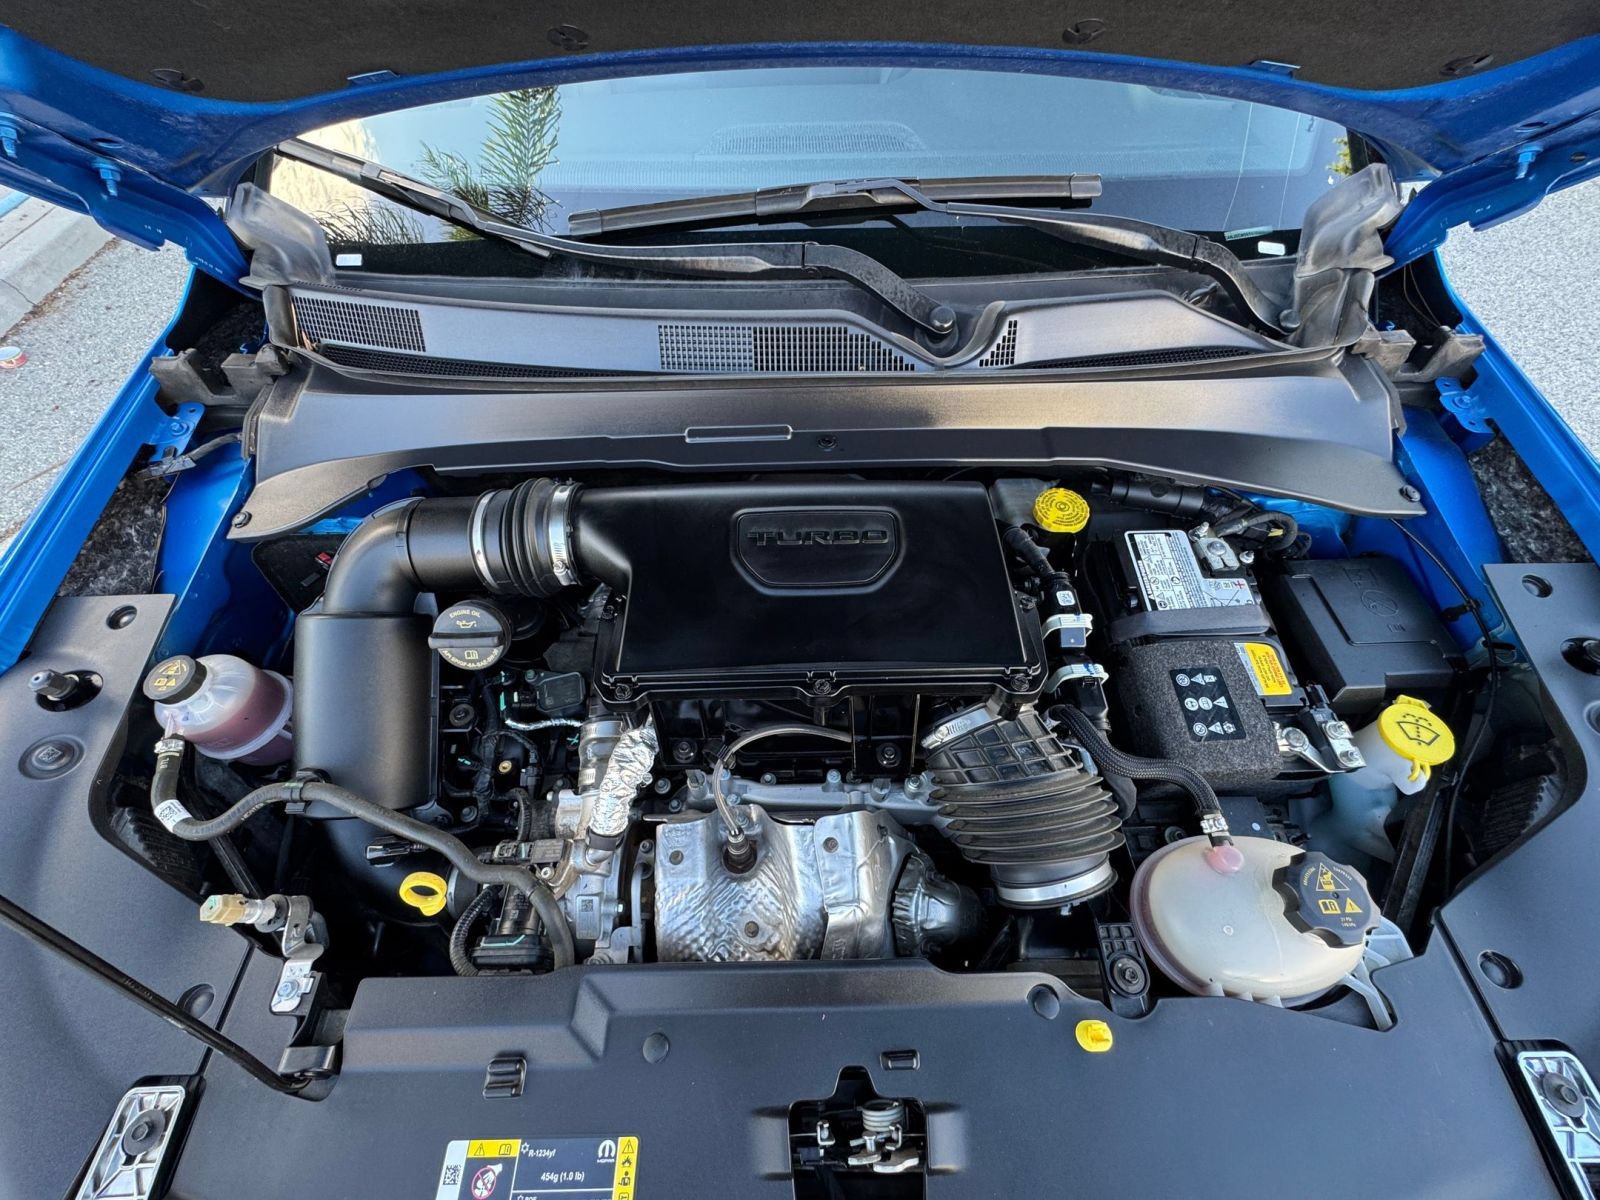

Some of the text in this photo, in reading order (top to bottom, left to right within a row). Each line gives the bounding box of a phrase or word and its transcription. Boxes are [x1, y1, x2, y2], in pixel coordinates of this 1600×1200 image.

[747, 530, 888, 546] TURBO
[449, 609, 480, 618] ENGINE OIL
[528, 1149, 556, 1158] R-1234yf
[541, 1171, 584, 1183] 454g (1.0 lb)
